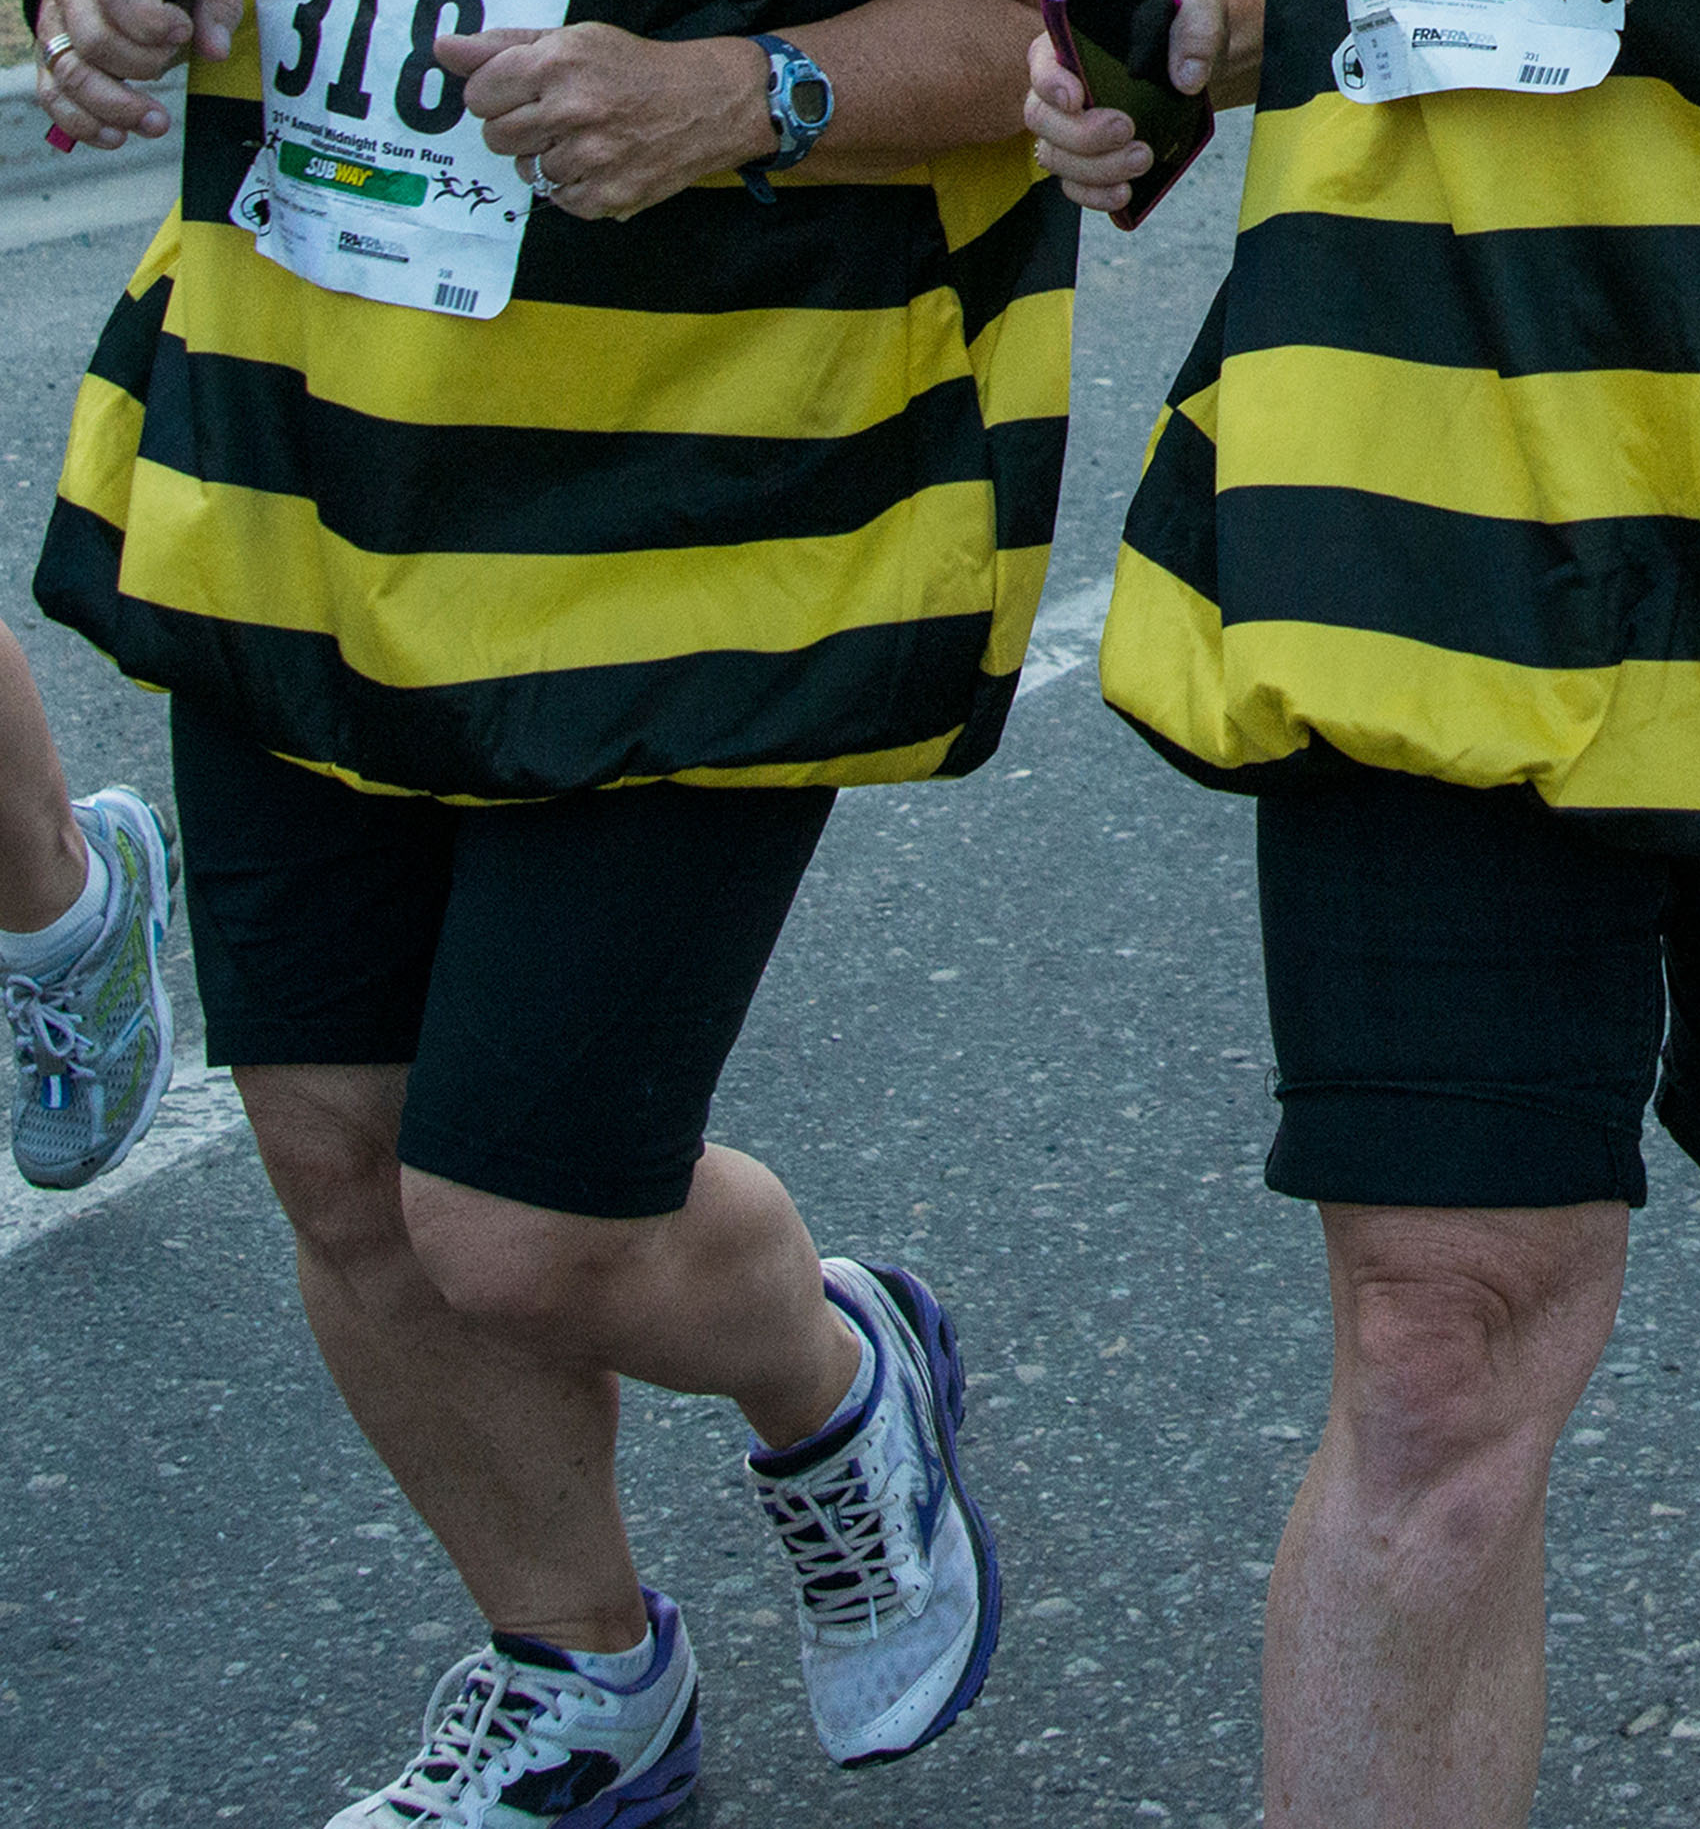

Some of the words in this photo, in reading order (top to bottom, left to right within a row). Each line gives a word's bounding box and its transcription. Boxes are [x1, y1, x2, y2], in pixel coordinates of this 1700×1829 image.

[324, 127, 377, 153] Midnight
[382, 142, 414, 159] Sun
[420, 149, 454, 166] Run
[304, 156, 373, 187] SUBWAY
